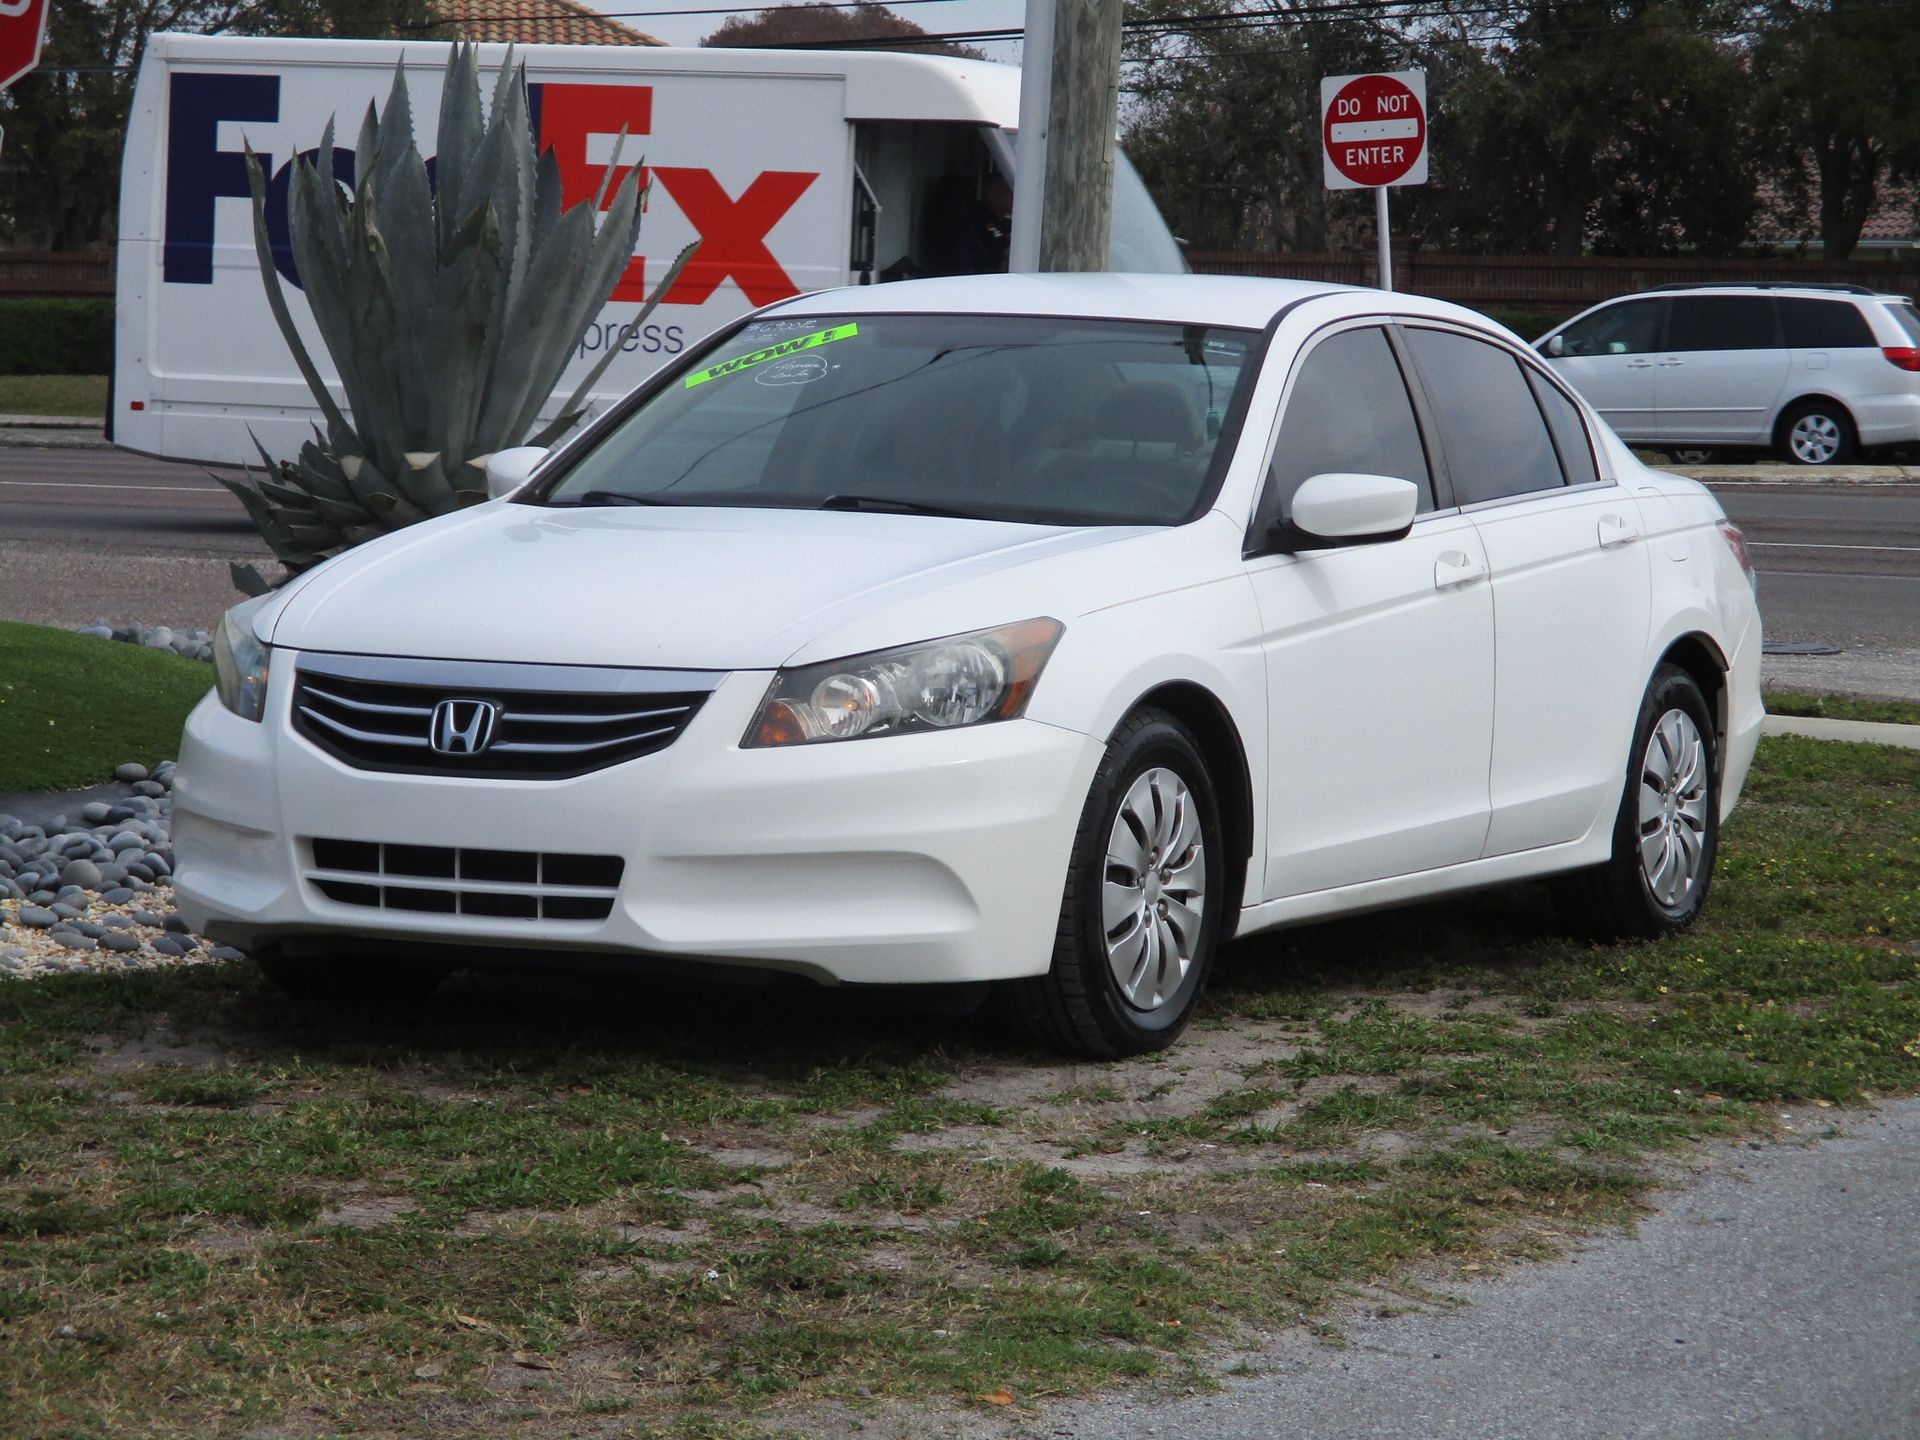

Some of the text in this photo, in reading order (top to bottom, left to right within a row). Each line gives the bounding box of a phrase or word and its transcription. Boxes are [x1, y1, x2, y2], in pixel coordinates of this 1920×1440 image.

[1338, 95, 1410, 116] DO NOT
[1346, 146, 1405, 166] ENTER
[164, 72, 821, 308] FEx
[580, 323, 684, 359] press
